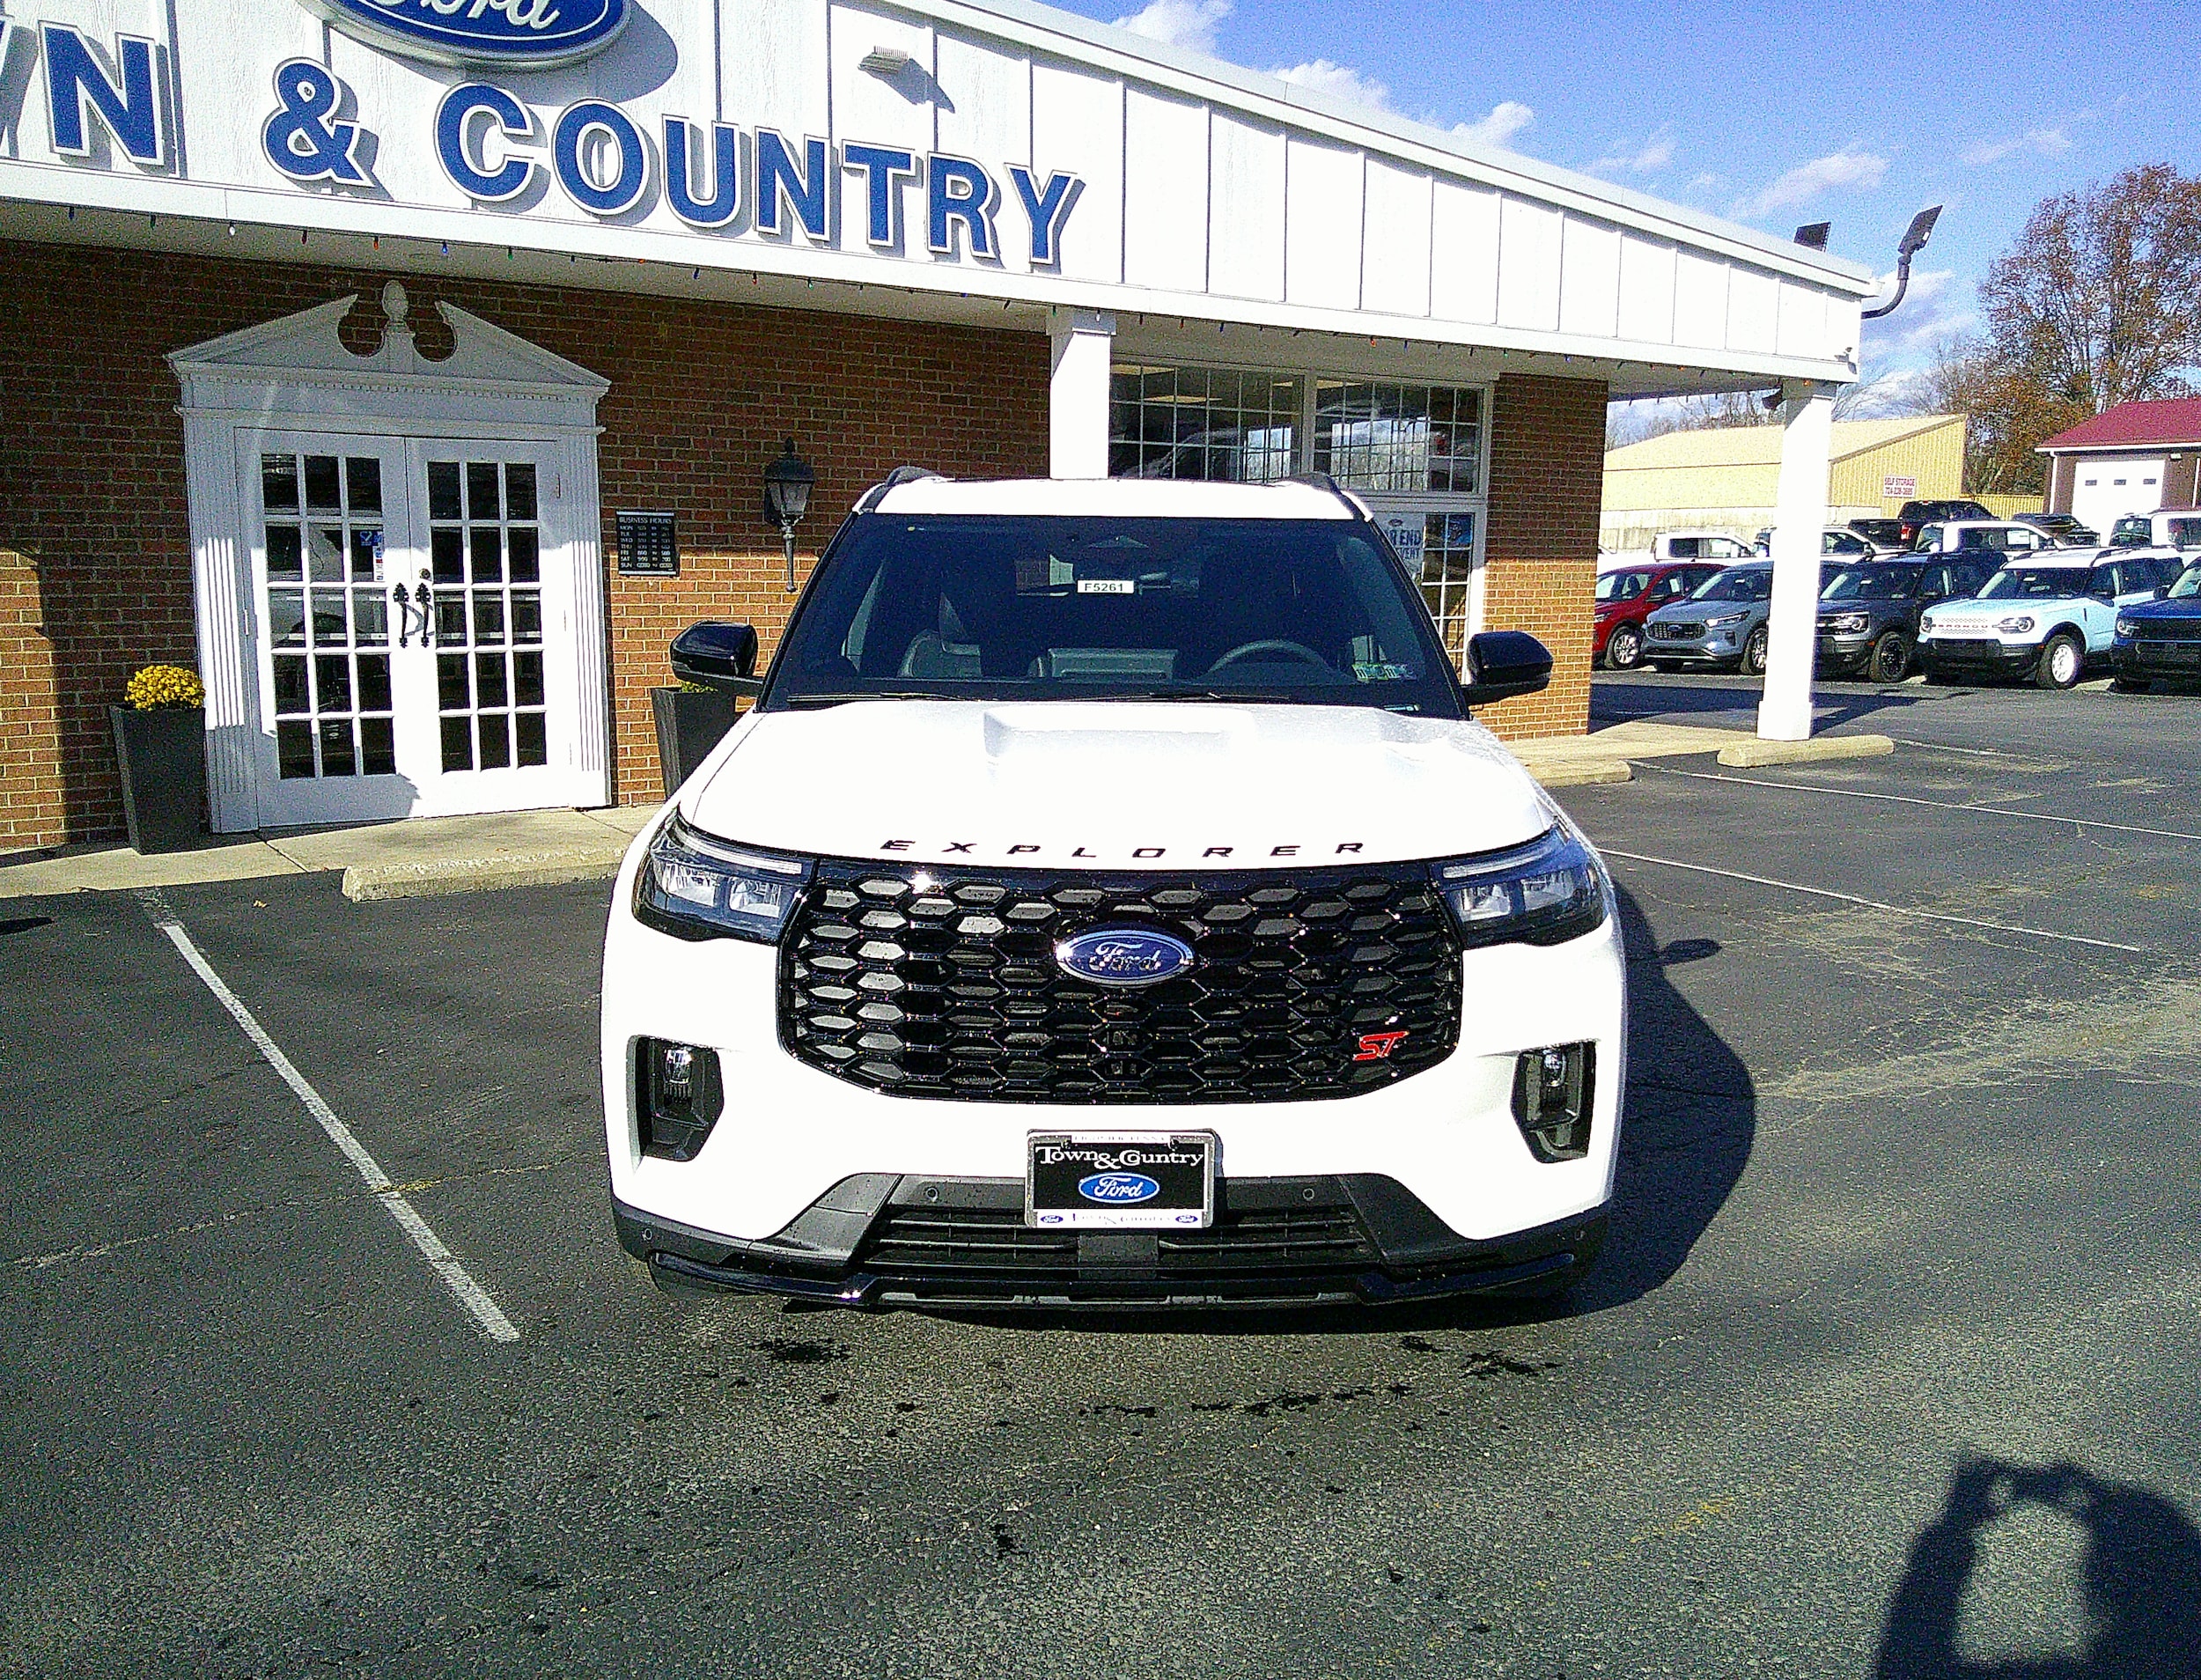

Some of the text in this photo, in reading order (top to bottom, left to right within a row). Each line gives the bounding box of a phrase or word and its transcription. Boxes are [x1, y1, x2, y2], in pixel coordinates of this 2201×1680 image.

[0, 15, 1078, 265] N & COUNTRY
[1896, 477, 1916, 487] STORAGE
[1400, 529, 1422, 546] END
[1084, 583, 1124, 592] F5261
[880, 839, 1365, 859] EXPLORER
[1088, 941, 1161, 971] Ford
[1352, 1031, 1410, 1061] ST
[1093, 1175, 1144, 1198] Ford
